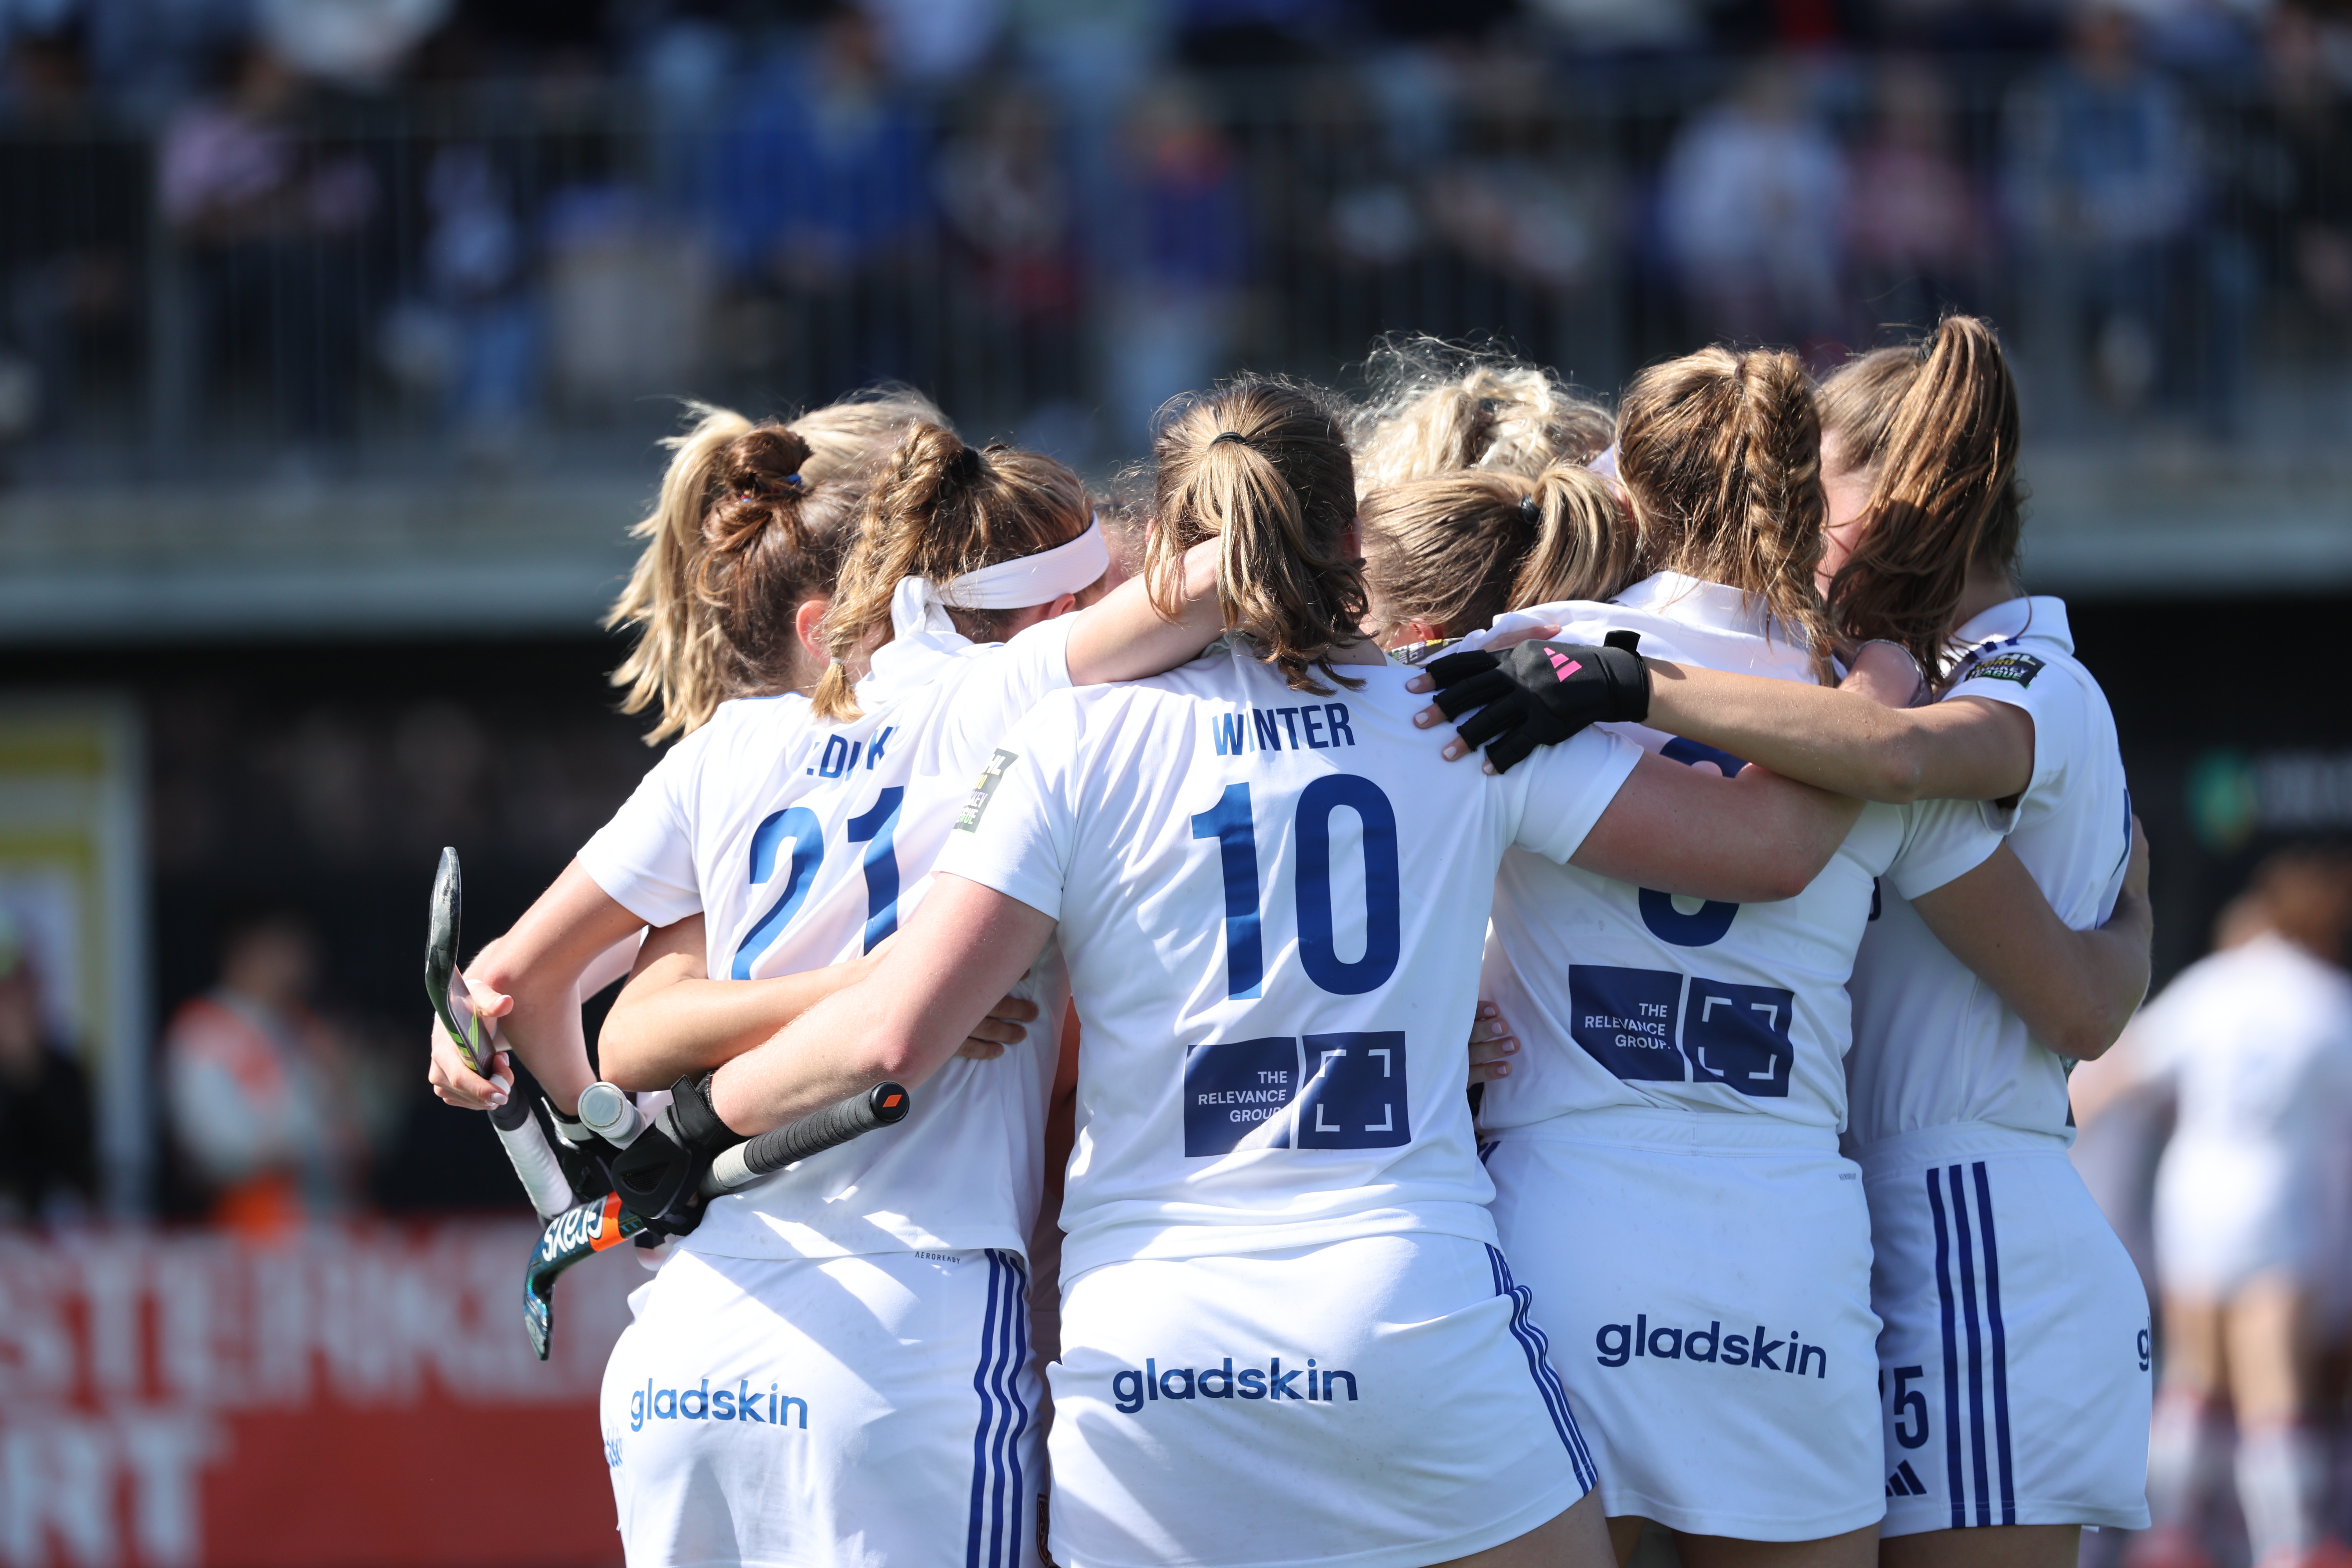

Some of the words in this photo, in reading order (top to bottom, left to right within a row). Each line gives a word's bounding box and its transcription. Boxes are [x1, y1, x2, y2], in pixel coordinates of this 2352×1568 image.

[1212, 702, 1356, 756] WINTER
[731, 785, 904, 980] 21
[1191, 773, 1400, 1000] 10
[1585, 1016, 1665, 1036] RELEVANCE
[1639, 1003, 1668, 1018] THE
[1615, 1034, 1671, 1050] GROUP.
[1198, 1089, 1286, 1105] RELEVANCE
[1257, 1071, 1287, 1083] THE
[915, 1251, 960, 1264] AEROREADY
[1596, 1314, 1826, 1379] gladskin
[630, 1377, 808, 1432] gladskin
[1112, 1357, 1357, 1414] gladskin
[1878, 1365, 1929, 1449] 5
